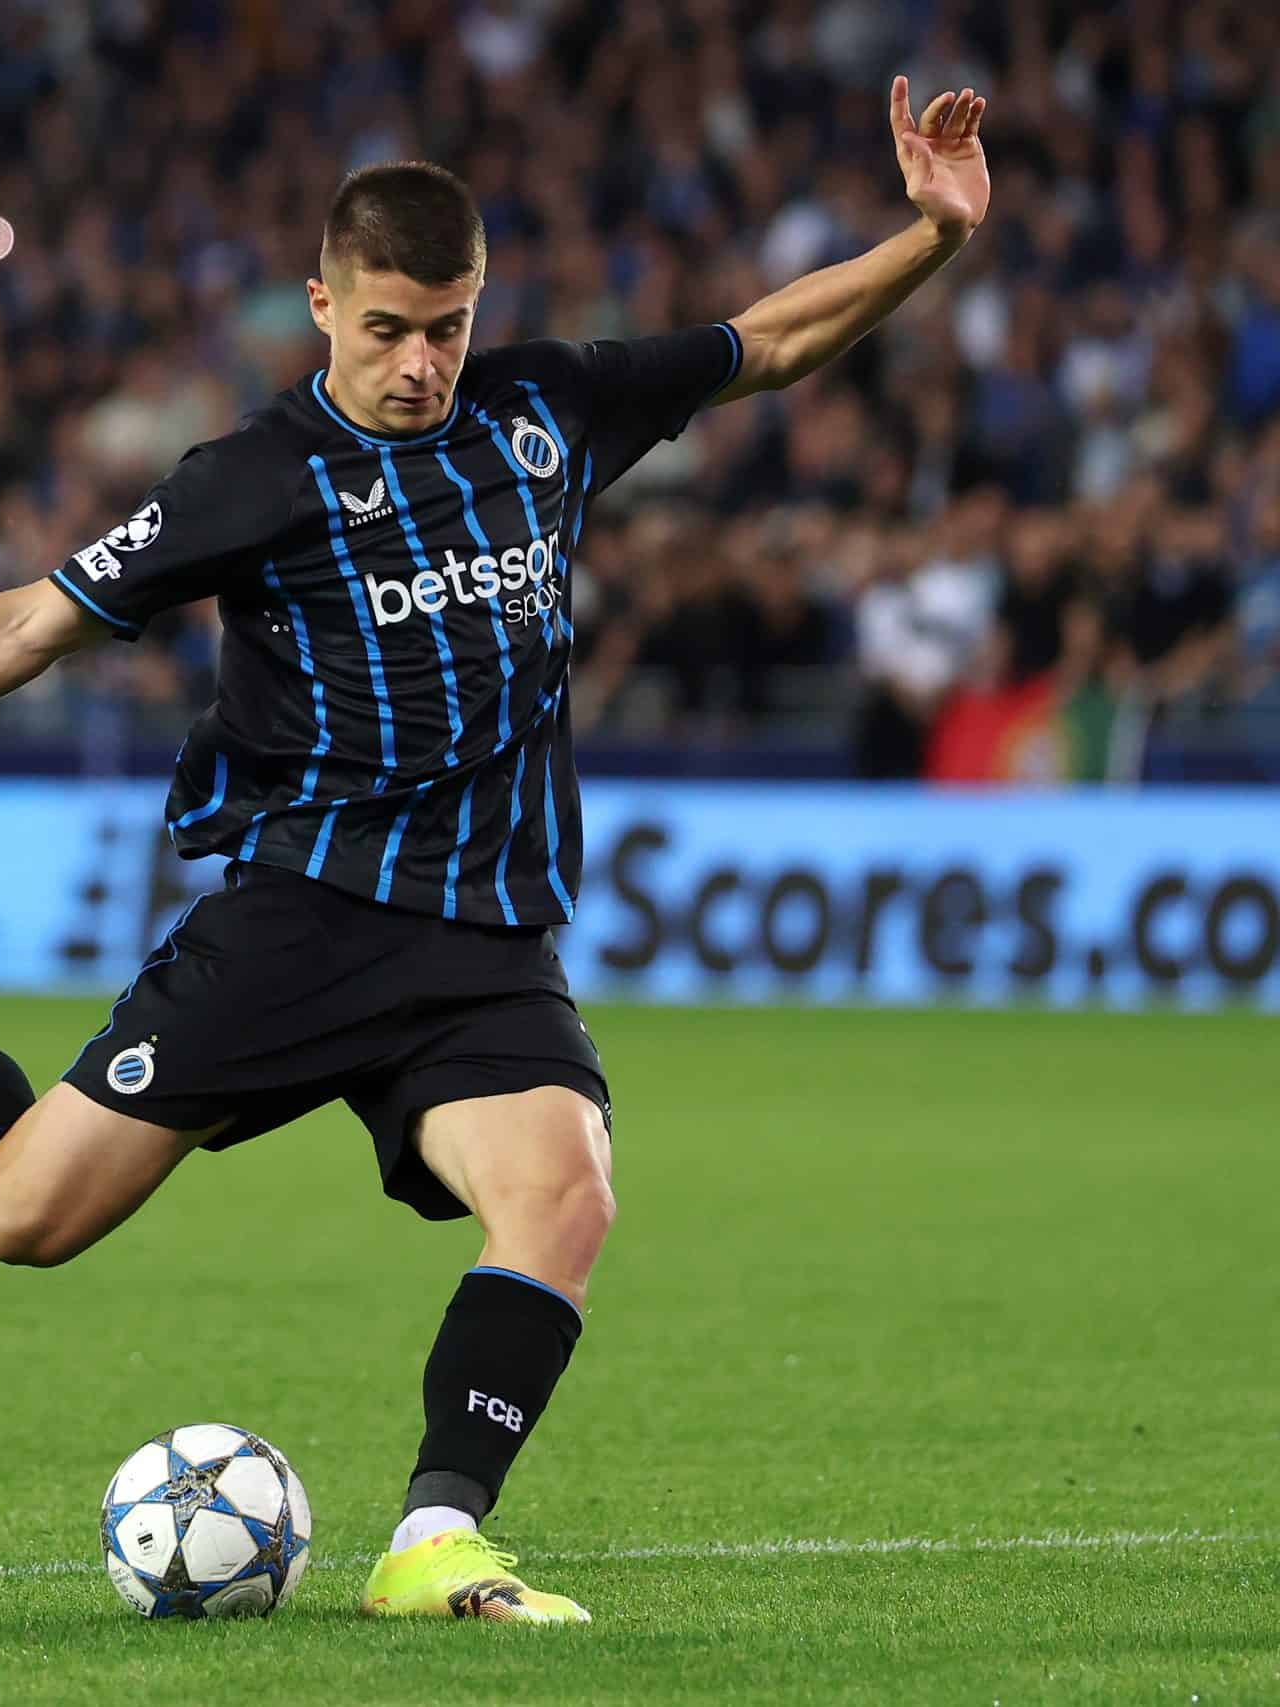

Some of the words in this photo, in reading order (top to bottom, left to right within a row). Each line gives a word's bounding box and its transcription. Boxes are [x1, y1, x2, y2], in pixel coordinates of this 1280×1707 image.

[348, 505, 393, 527] CASTORE
[364, 530, 559, 627] betsson
[467, 1388, 524, 1433] FCB
